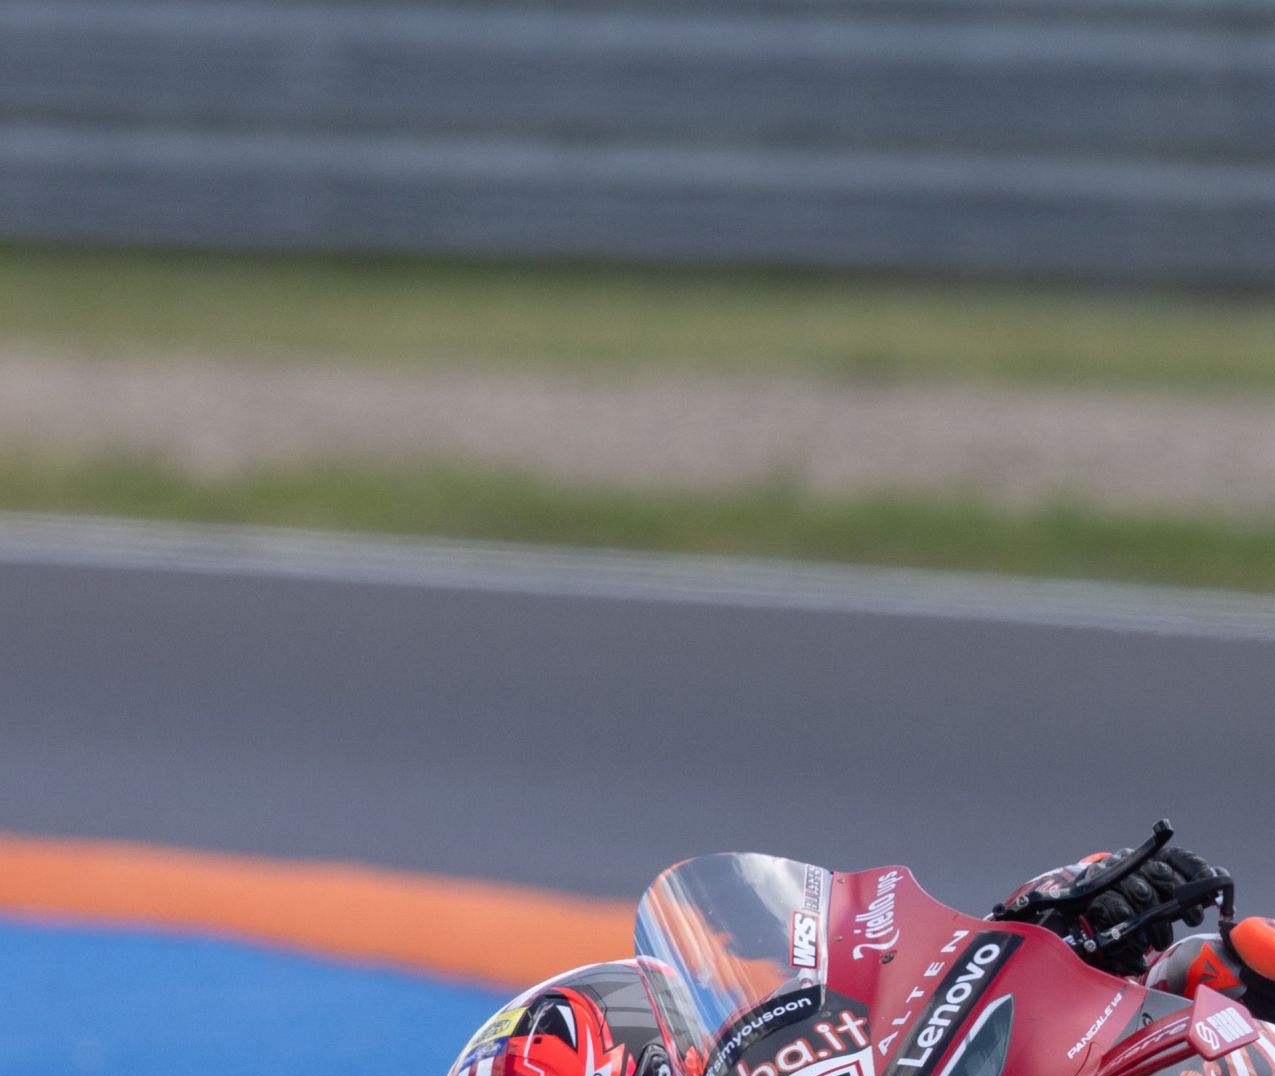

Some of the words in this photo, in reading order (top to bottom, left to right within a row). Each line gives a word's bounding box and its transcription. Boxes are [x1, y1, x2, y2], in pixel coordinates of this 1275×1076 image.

[713, 996, 813, 1072] simyousoon
[877, 930, 970, 1056] ALTEN
[896, 943, 1001, 1068] Lenovo
[1067, 1005, 1114, 1060] PANIGALE
